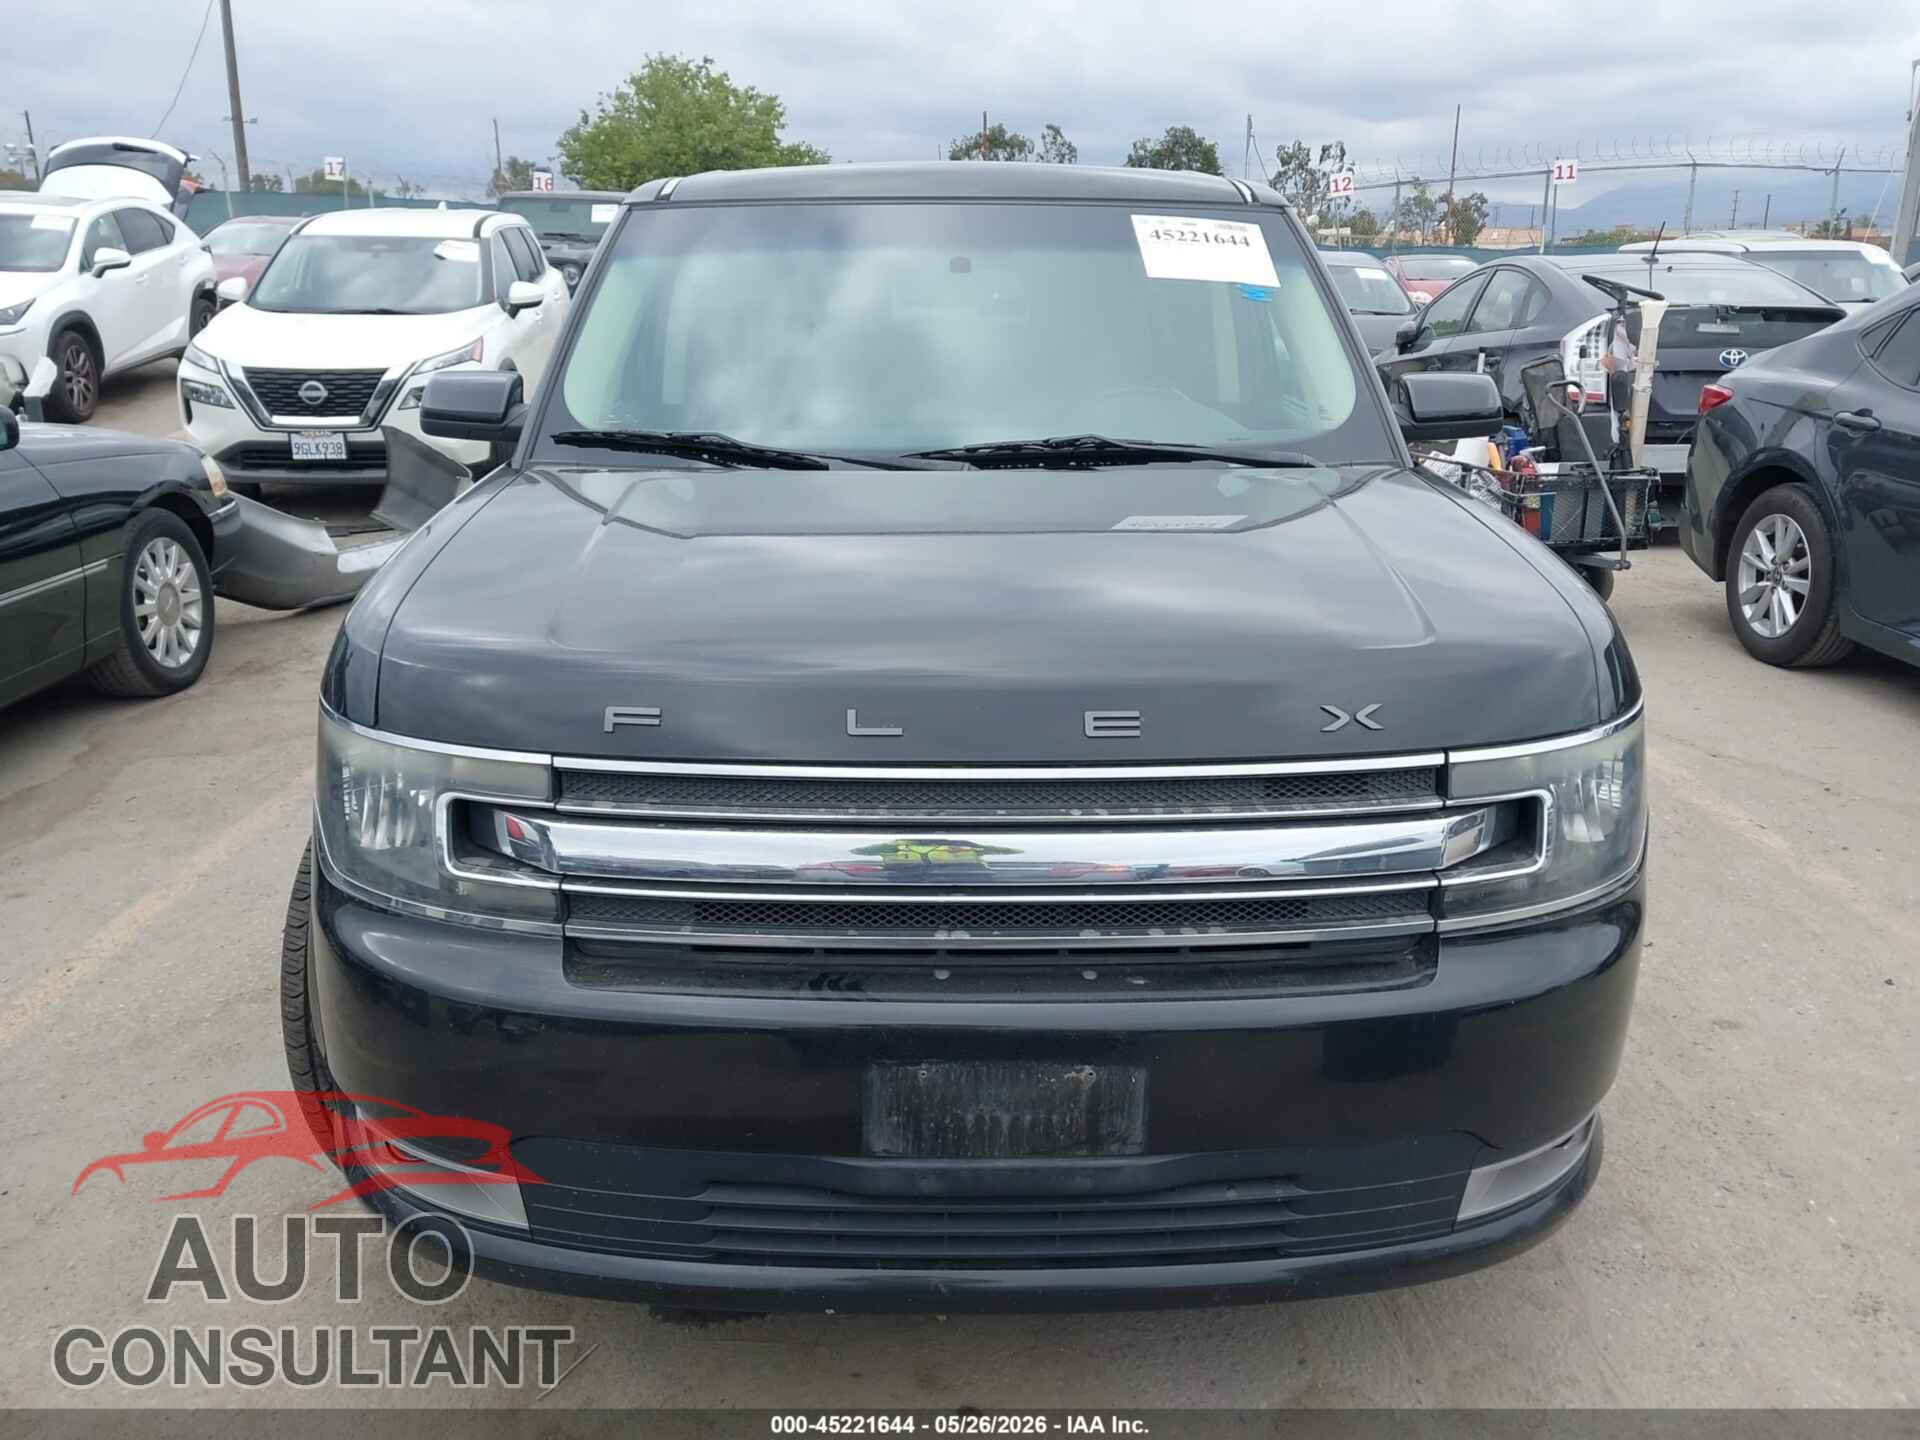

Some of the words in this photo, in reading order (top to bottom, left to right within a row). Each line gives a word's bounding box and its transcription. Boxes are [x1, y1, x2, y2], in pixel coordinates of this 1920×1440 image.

[327, 161, 345, 176] 17
[1554, 164, 1576, 180] 11
[534, 175, 553, 192] 16
[1331, 176, 1352, 193] 12
[1150, 228, 1251, 247] 45221644
